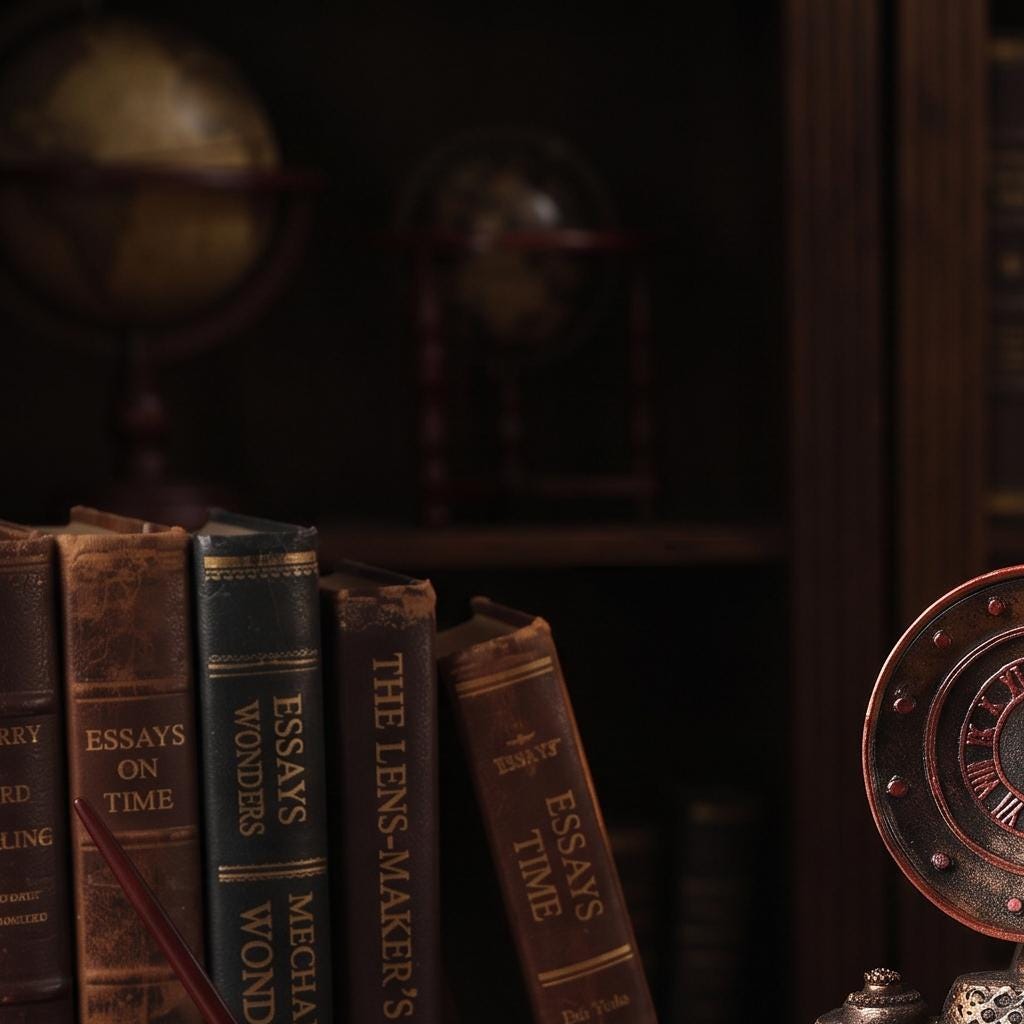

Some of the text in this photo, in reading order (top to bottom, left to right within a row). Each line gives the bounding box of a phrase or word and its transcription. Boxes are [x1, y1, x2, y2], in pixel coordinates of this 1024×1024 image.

[371, 652, 405, 731] THE
[85, 724, 186, 751] ESSAYS
[117, 758, 159, 780] ON
[234, 700, 265, 836] WONDERS
[273, 693, 307, 824] ESSAYS
[104, 789, 175, 814] TIME
[513, 828, 563, 922] TIME
[546, 789, 604, 922] ESSAYS
